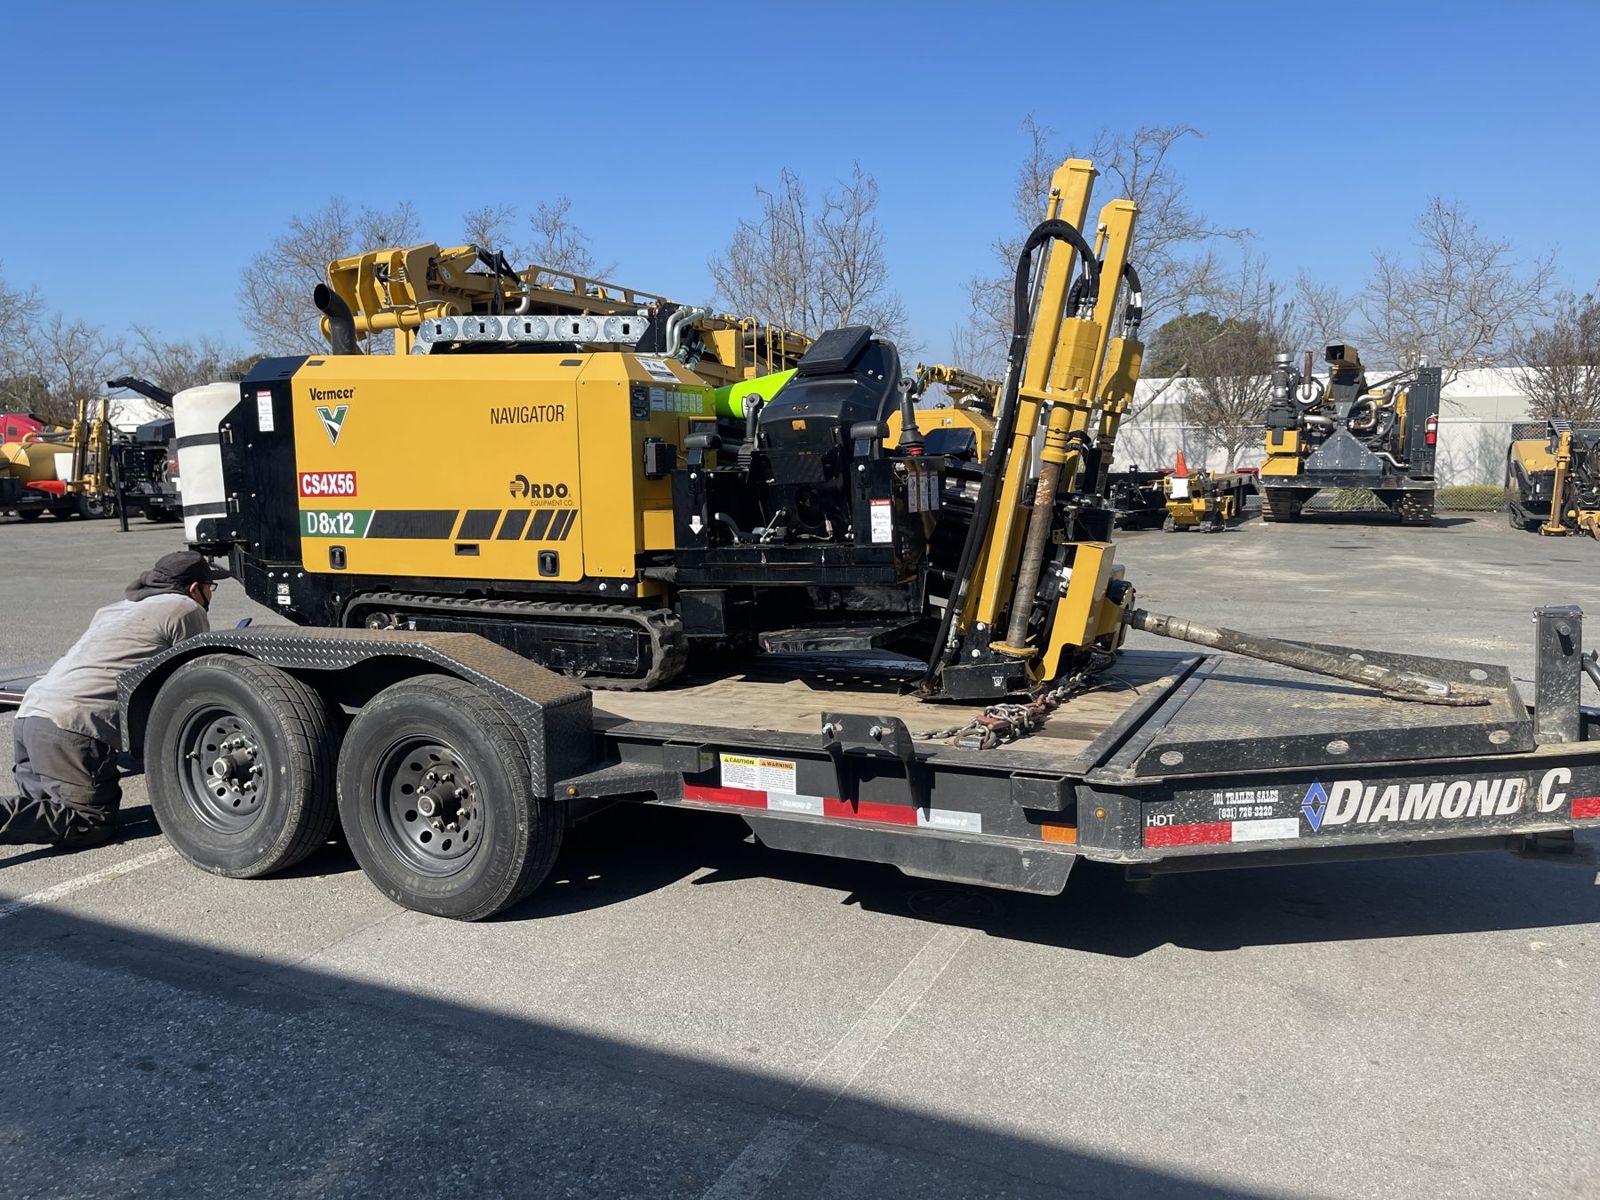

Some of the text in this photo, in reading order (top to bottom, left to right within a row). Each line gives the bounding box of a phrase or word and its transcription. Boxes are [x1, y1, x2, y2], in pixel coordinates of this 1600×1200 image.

[309, 387, 354, 401] Vermeer
[490, 404, 565, 424] NAVIGATOR
[302, 473, 355, 495] CS4X56
[729, 757, 755, 765] CAUTION
[766, 761, 793, 769] WARNING
[1213, 790, 1279, 806] 101 TRAILER SALES
[1322, 767, 1572, 826] DIAMOND C
[1146, 814, 1176, 827] HDT
